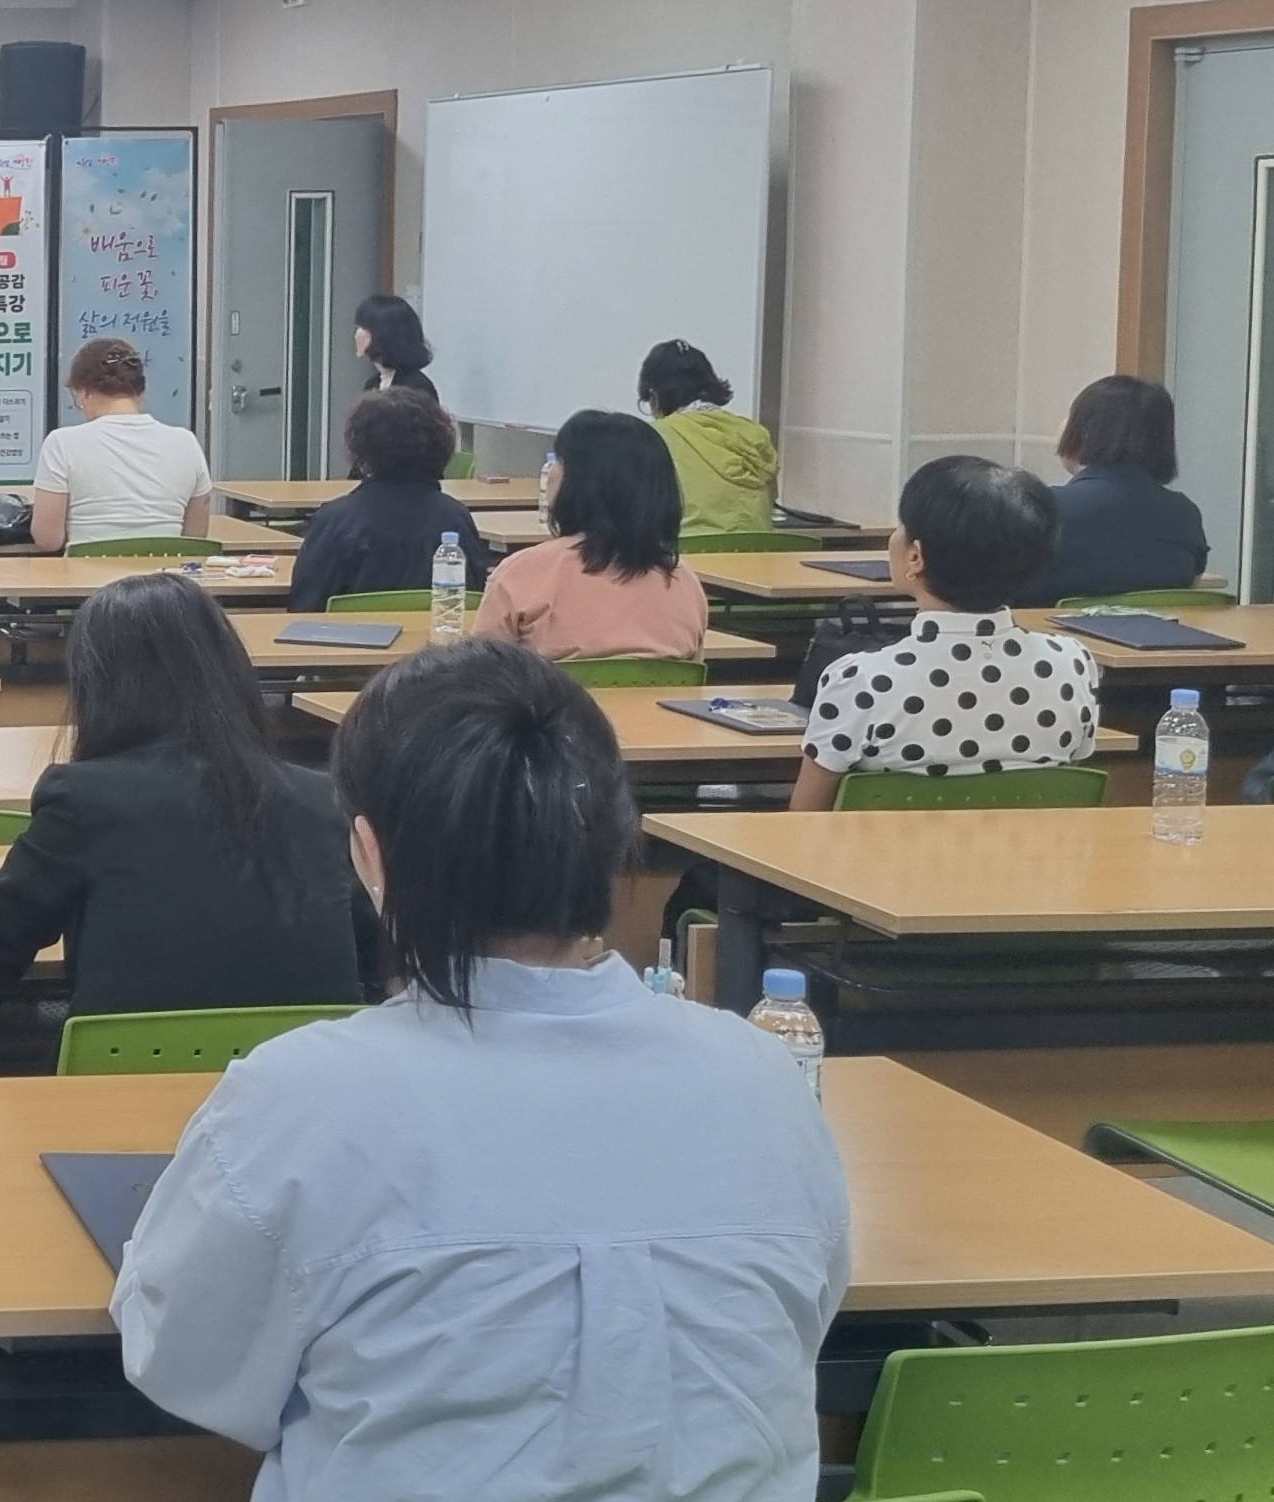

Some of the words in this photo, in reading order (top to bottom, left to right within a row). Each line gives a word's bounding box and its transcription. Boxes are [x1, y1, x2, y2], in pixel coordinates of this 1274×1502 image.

[91, 231, 158, 262] 배움으로
[99, 274, 131, 298] 피운
[79, 310, 117, 339] 삶의
[122, 309, 170, 336] 정원을
